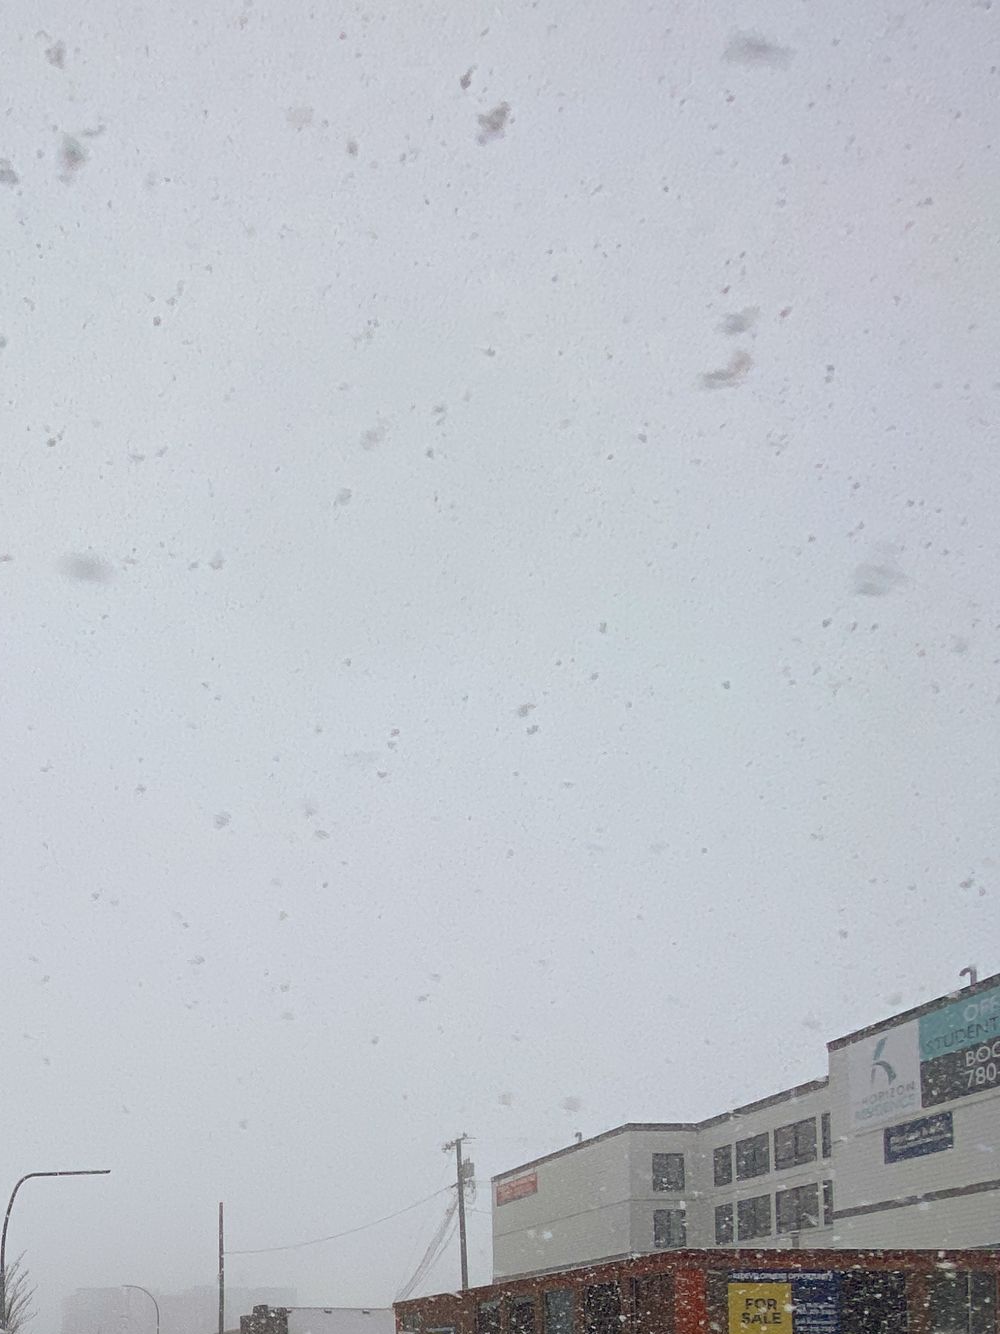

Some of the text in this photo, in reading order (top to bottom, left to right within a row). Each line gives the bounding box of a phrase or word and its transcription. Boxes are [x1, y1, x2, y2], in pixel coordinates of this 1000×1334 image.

[926, 1015, 999, 1050] STUDENT
[745, 1298, 777, 1310] FOR
[741, 1312, 781, 1324] SALE
